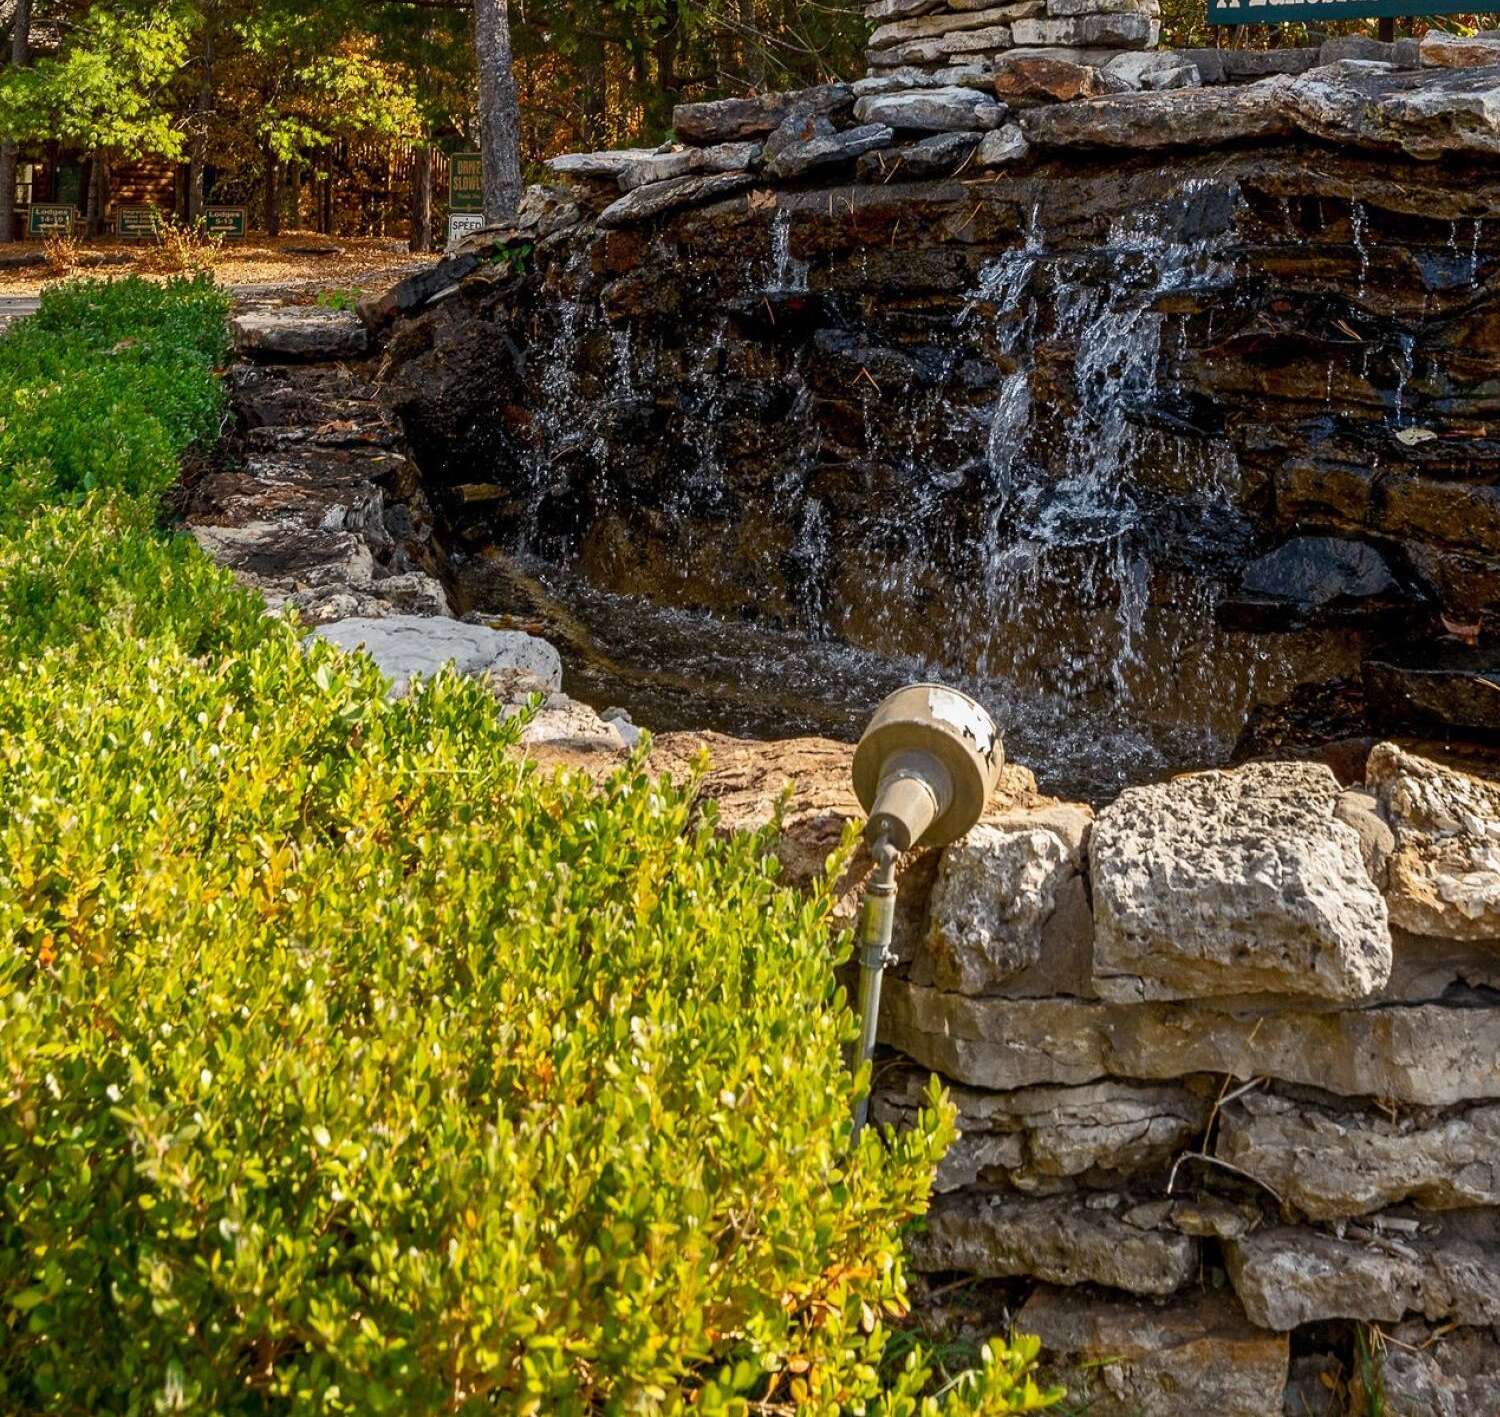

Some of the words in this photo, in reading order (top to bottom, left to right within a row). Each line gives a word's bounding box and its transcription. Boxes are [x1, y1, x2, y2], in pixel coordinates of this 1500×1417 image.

[457, 160, 482, 175] DRIVE
[208, 211, 241, 219] Lodges
[452, 220, 482, 231] SPEED
